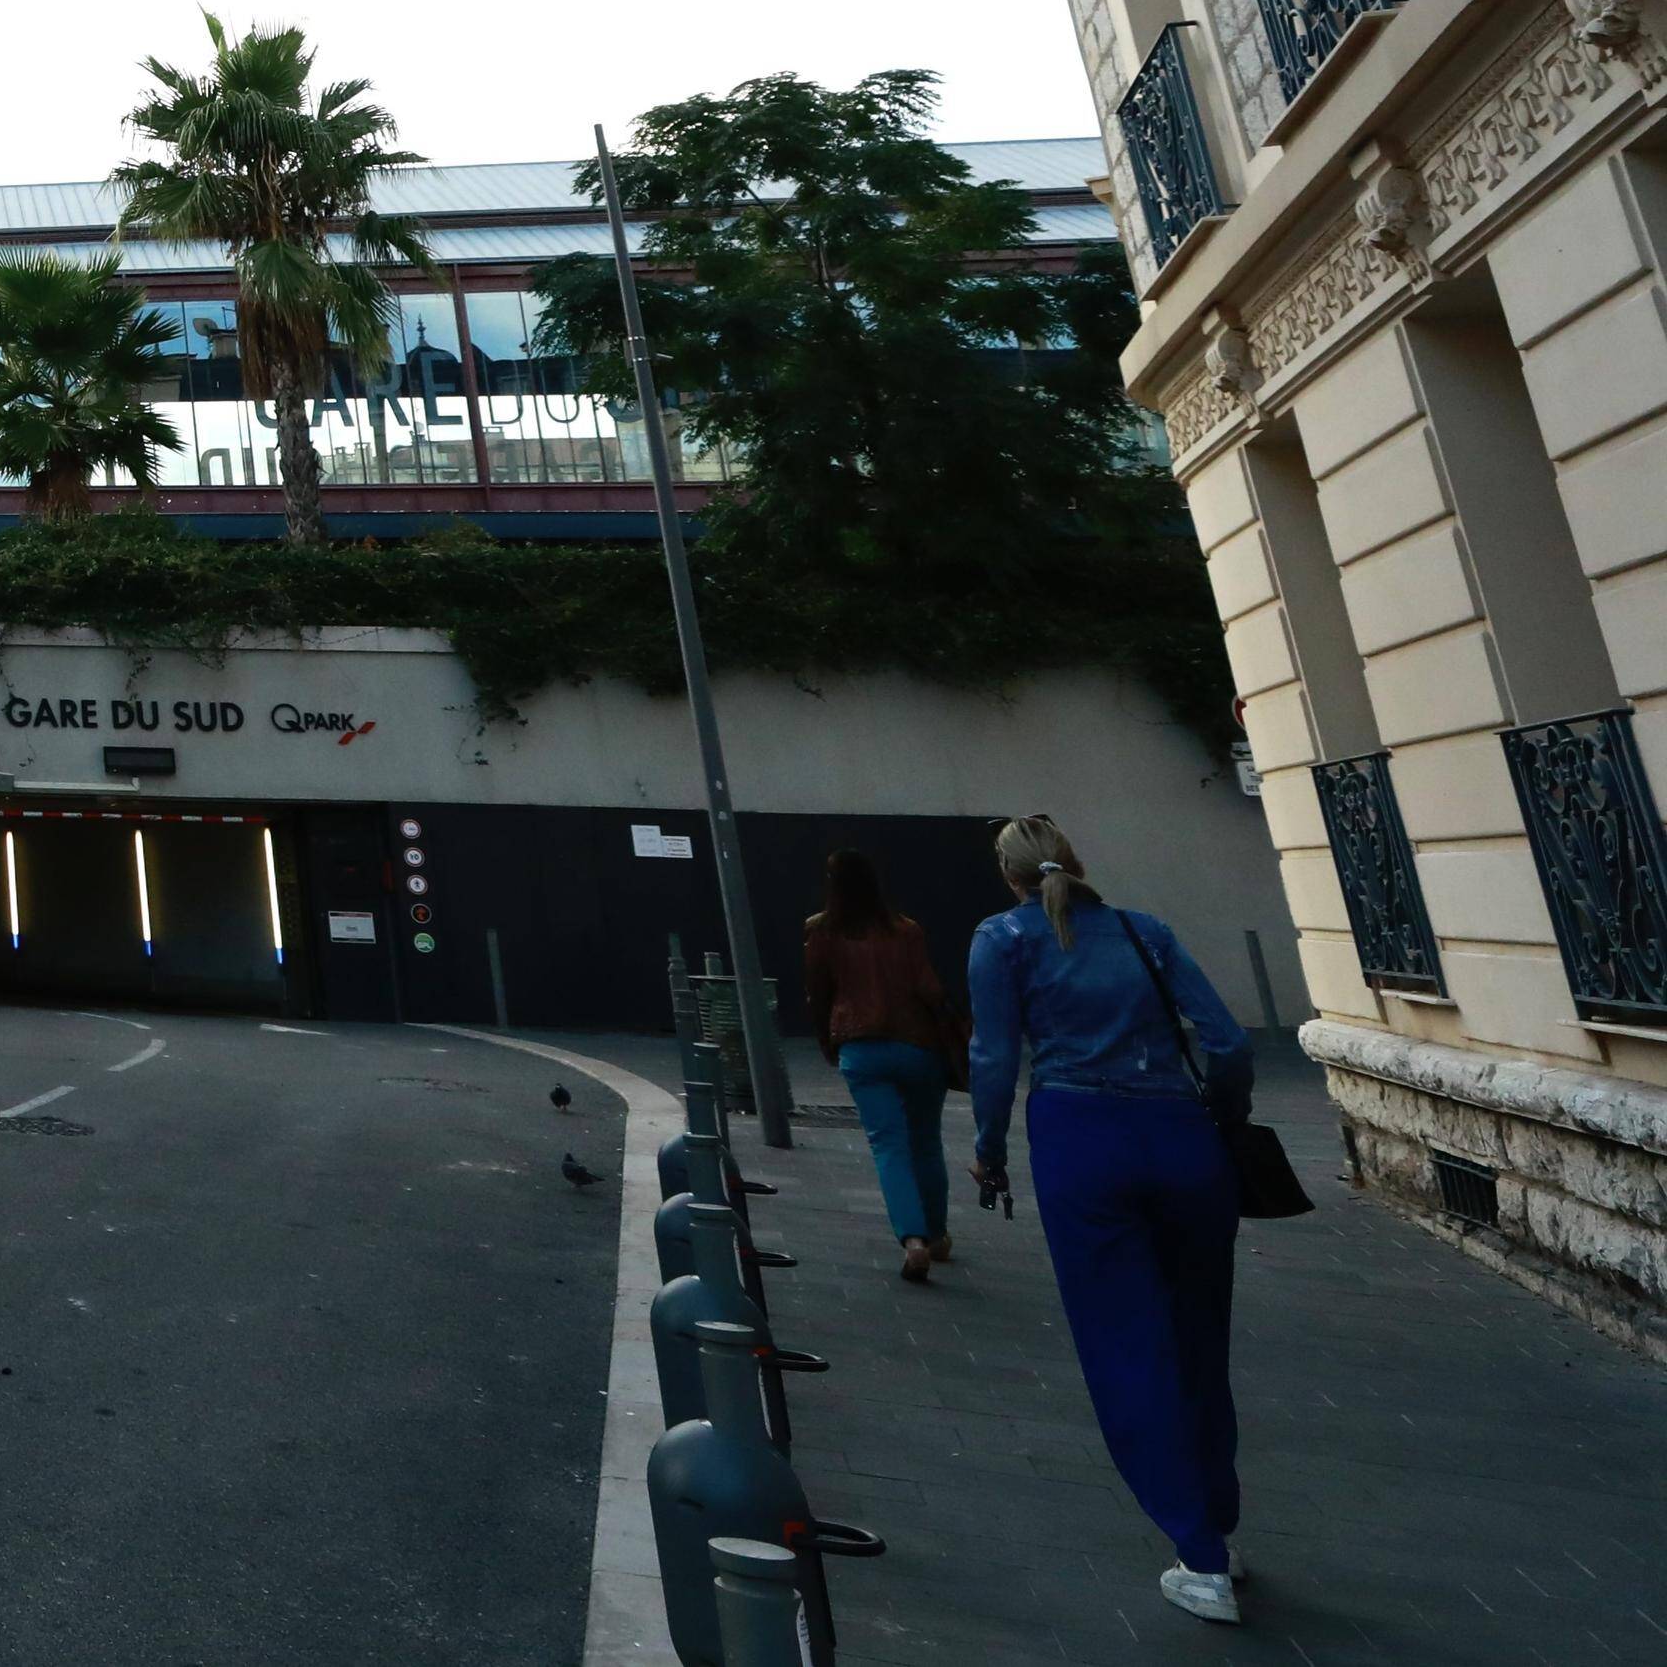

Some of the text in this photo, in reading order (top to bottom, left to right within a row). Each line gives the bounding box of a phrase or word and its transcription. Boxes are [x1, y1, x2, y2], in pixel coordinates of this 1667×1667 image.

[5, 698, 244, 732] GARE DU SUD
